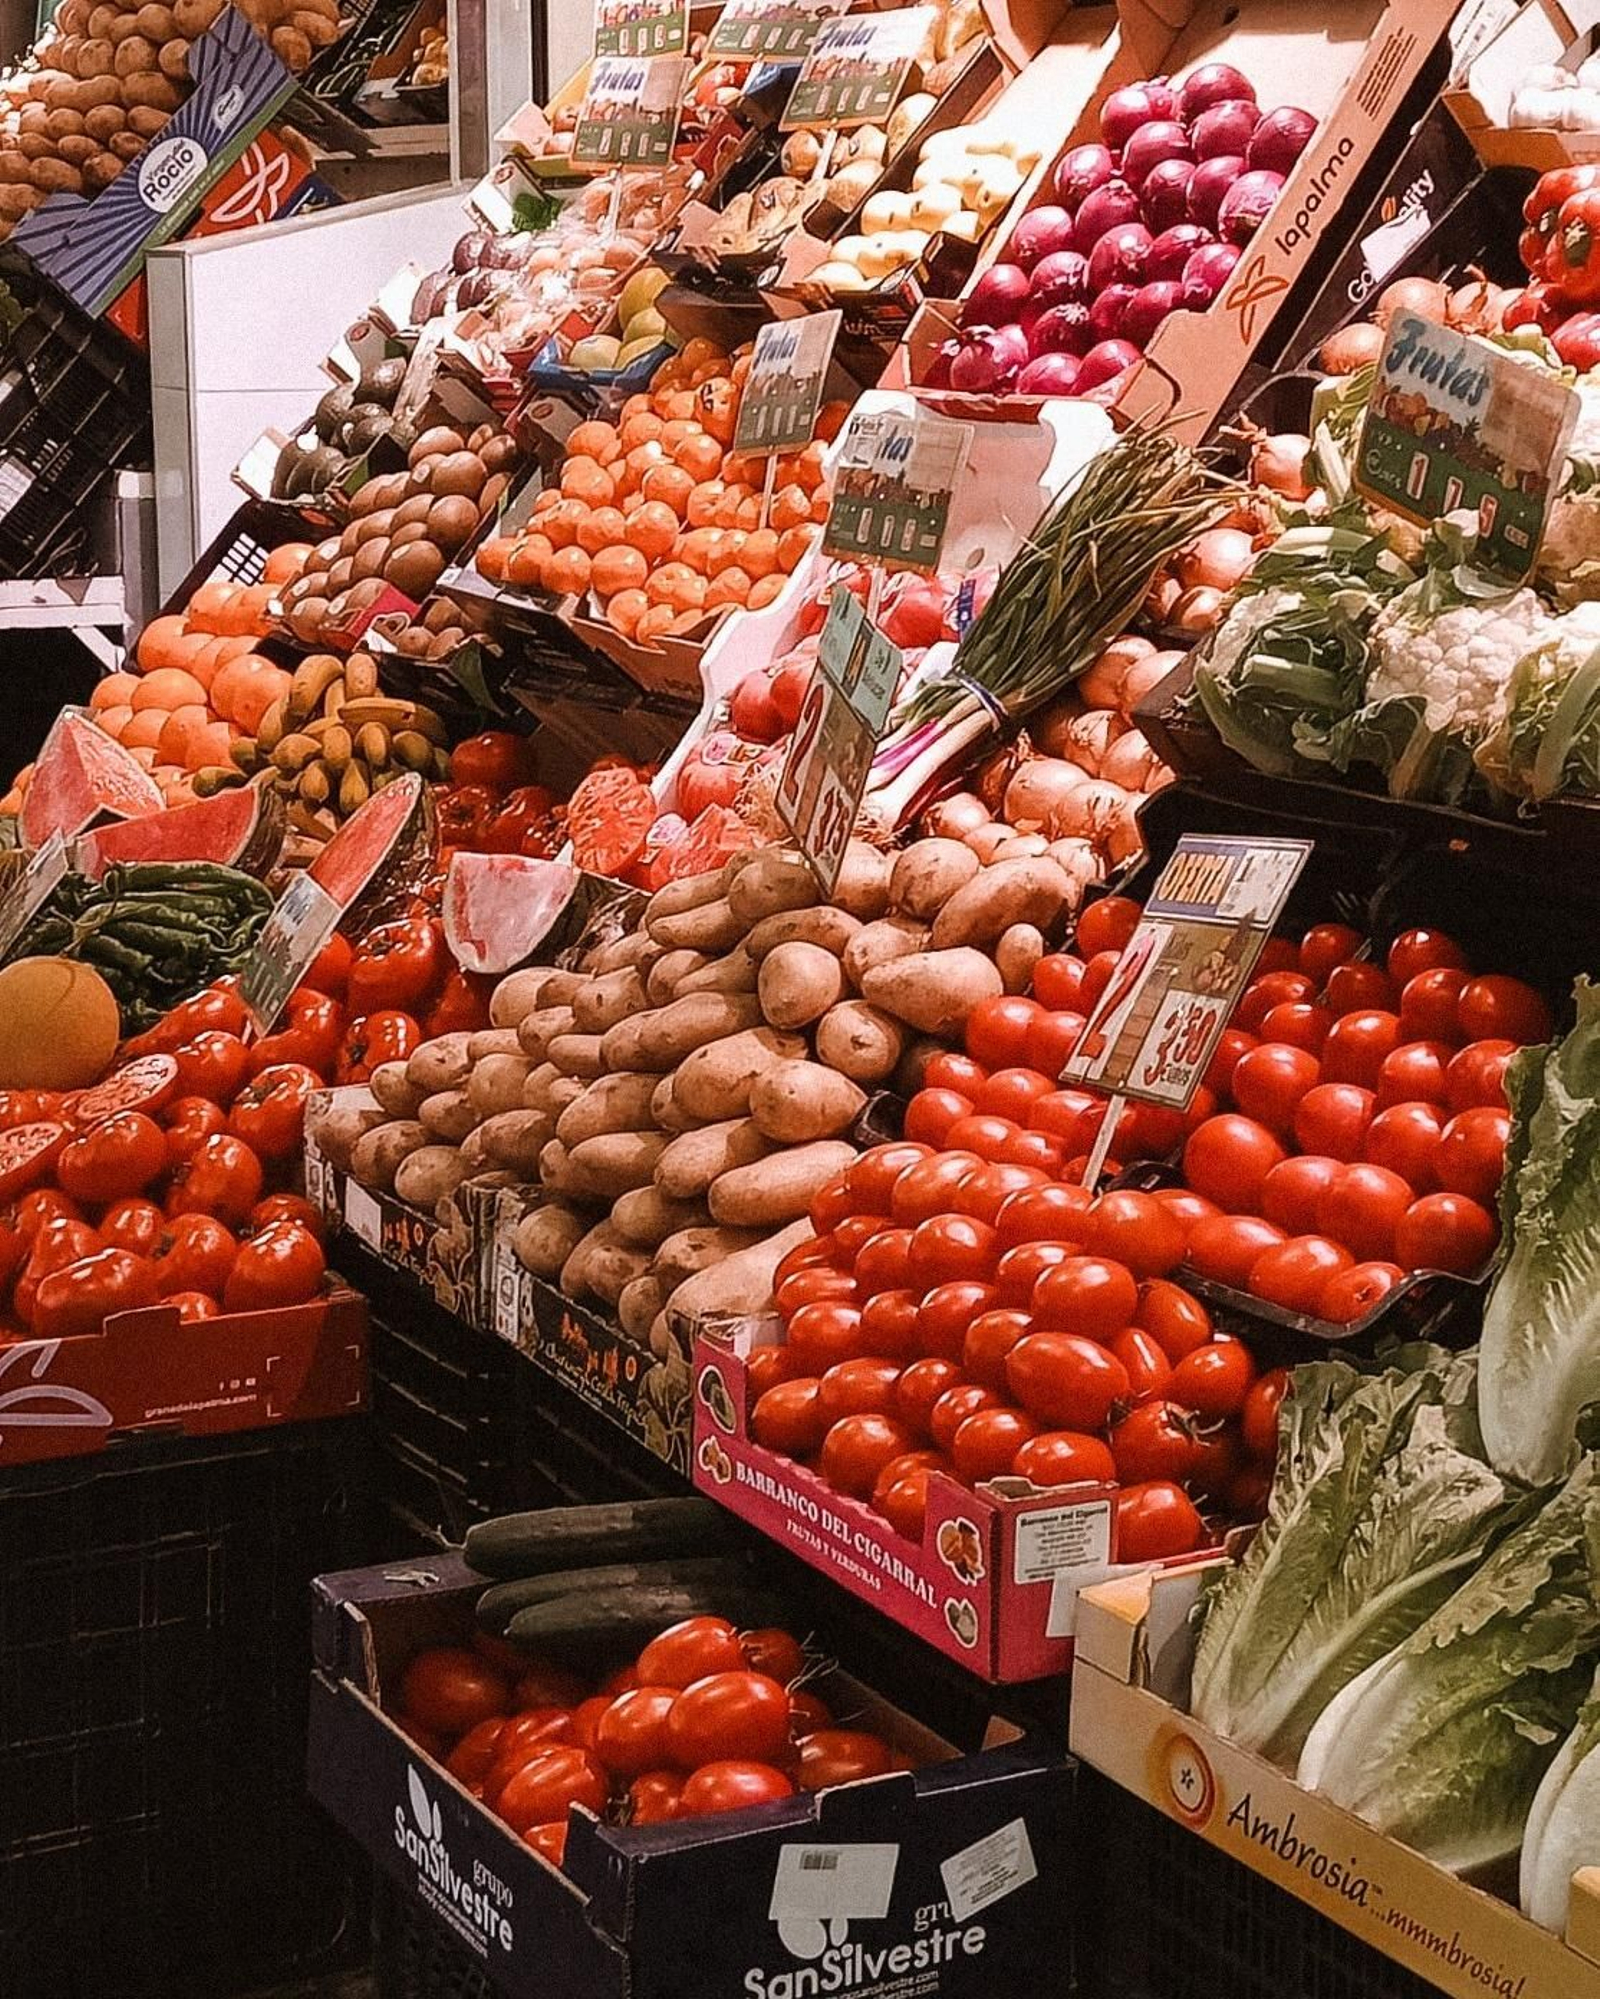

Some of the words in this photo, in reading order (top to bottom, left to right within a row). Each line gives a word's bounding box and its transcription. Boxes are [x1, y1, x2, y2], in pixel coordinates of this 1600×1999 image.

[1274, 137, 1355, 256] lapalma
[1385, 318, 1490, 406] Frutas
[1157, 851, 1237, 905] OFERTA
[735, 1460, 819, 1523] BARRANCO
[821, 1509, 852, 1546] DEL
[854, 1532, 938, 1609] CIGARRAL
[394, 1804, 514, 1951] SanSilvestre
[473, 1858, 514, 1909] grupo
[744, 1926, 987, 1999] SanSilvestre
